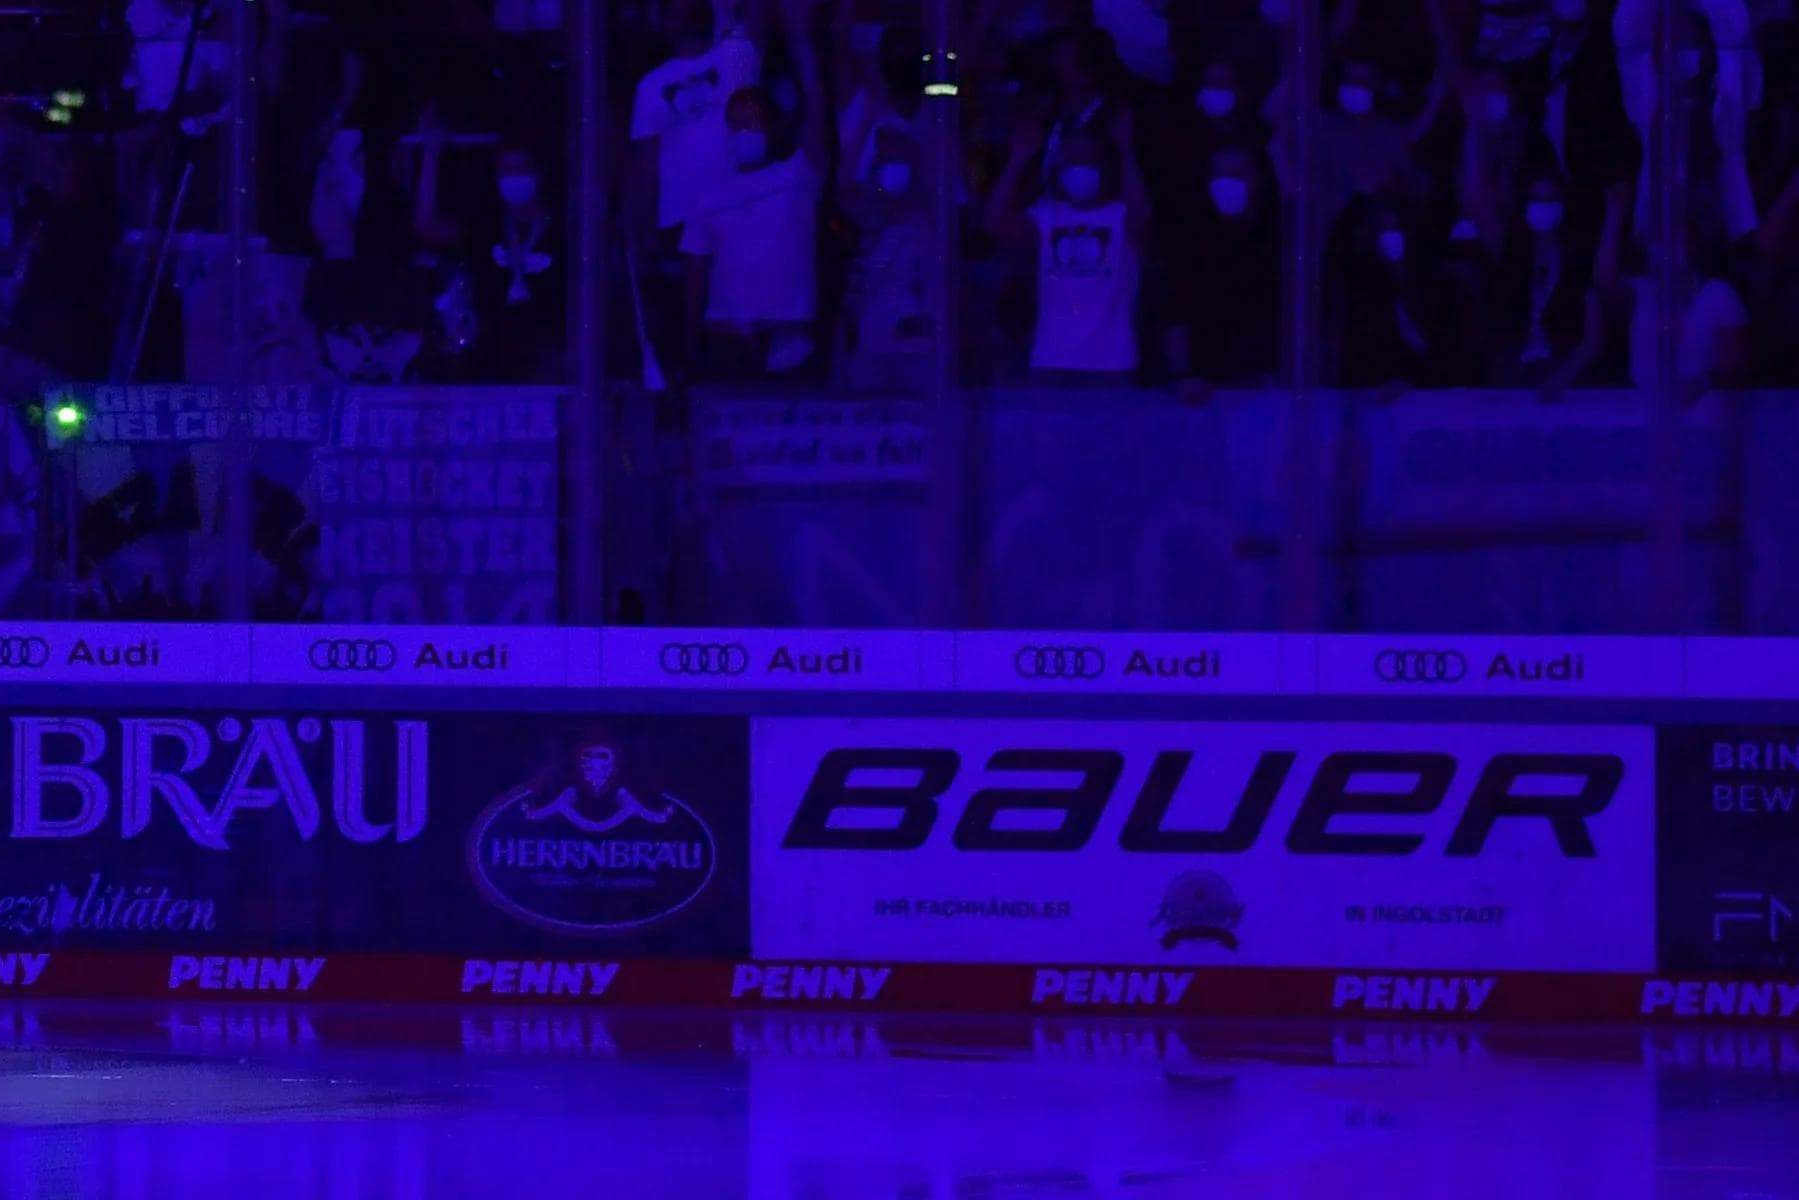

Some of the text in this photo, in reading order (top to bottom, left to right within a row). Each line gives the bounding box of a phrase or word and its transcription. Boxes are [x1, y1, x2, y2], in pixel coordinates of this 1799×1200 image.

[66, 639, 160, 668] Audi
[413, 643, 508, 671] Audi
[766, 646, 862, 675] Audi
[1123, 650, 1220, 679] Audi
[1486, 653, 1585, 681] Audi
[781, 747, 1625, 859] BAUER
[490, 836, 704, 870] HERRNBRÄU
[1371, 904, 1508, 926] INGOLSTADT
